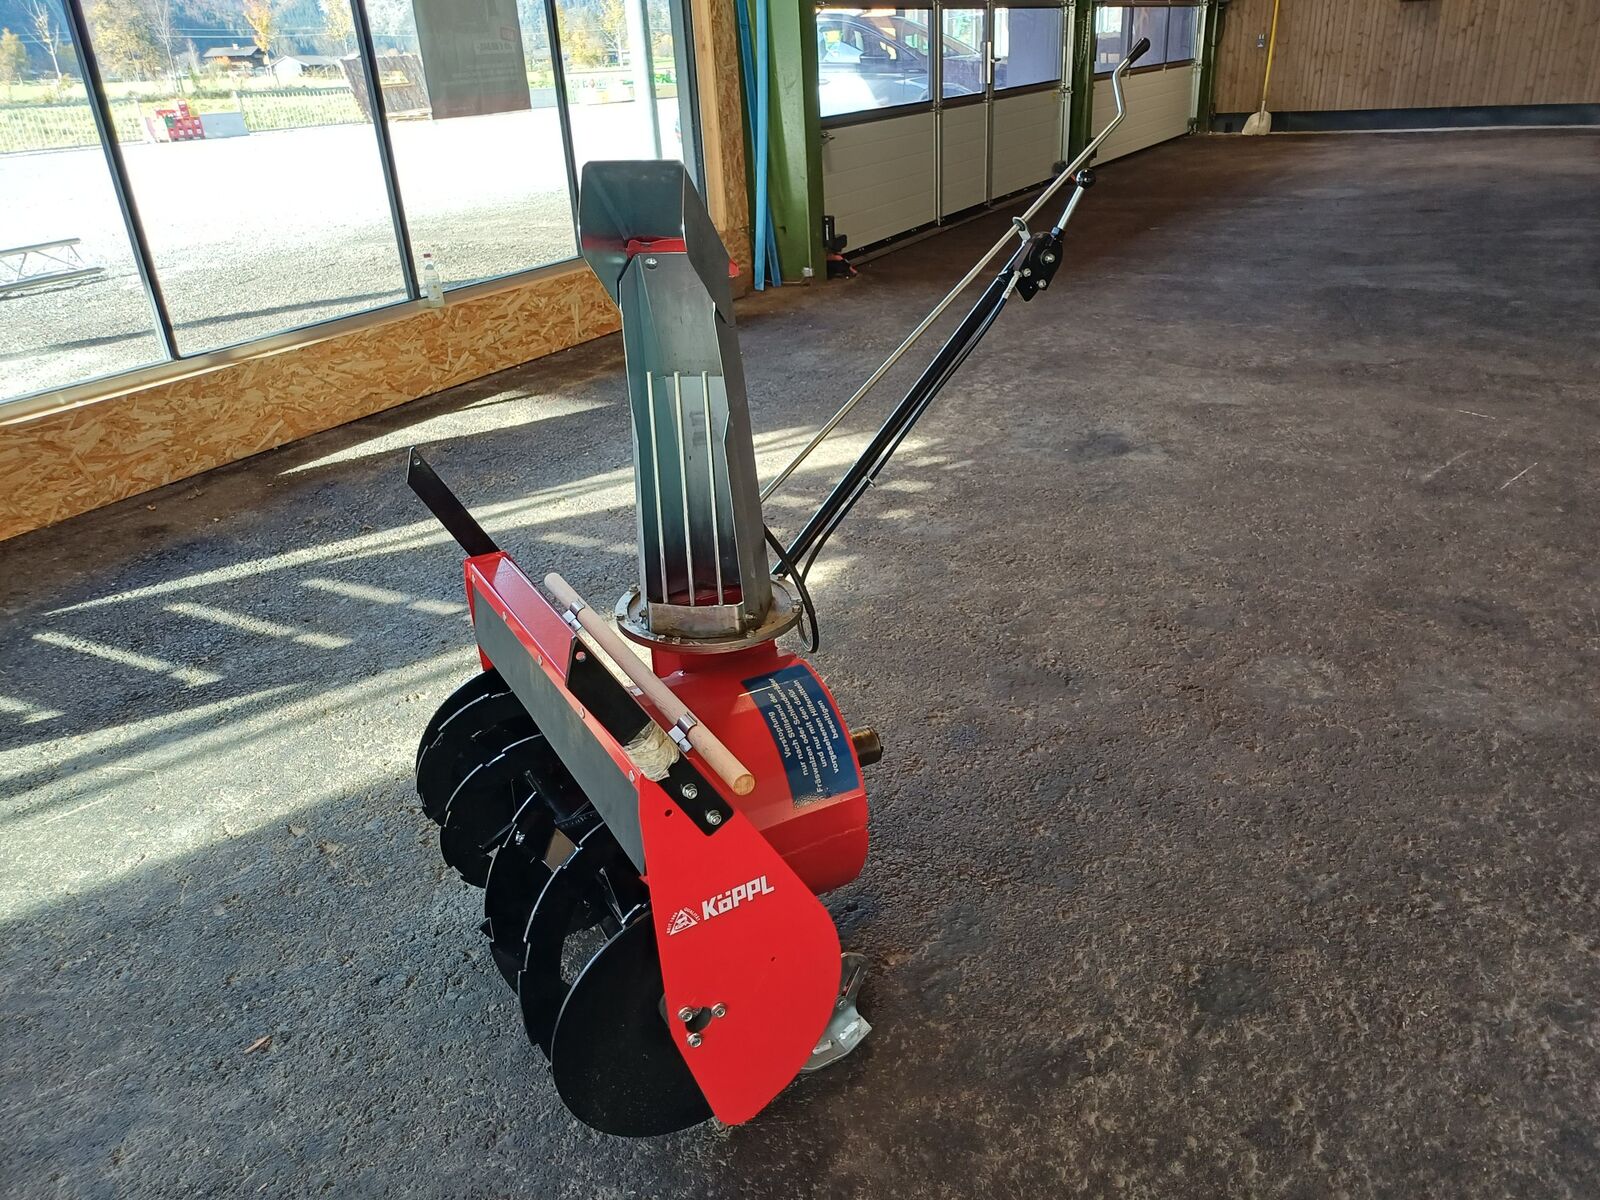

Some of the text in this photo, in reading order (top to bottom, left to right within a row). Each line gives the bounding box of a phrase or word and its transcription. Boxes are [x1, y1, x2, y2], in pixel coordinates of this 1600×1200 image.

[768, 692, 808, 776] nur nach Stillstand der
[768, 711, 791, 758] Verstopfung
[787, 688, 827, 767] und nur mit den dafür
[793, 679, 839, 774] vorgesehenen Hilfsmitteln
[798, 726, 808, 744] oder
[817, 700, 838, 740] beseitigen
[805, 745, 823, 793] Fräswalzen
